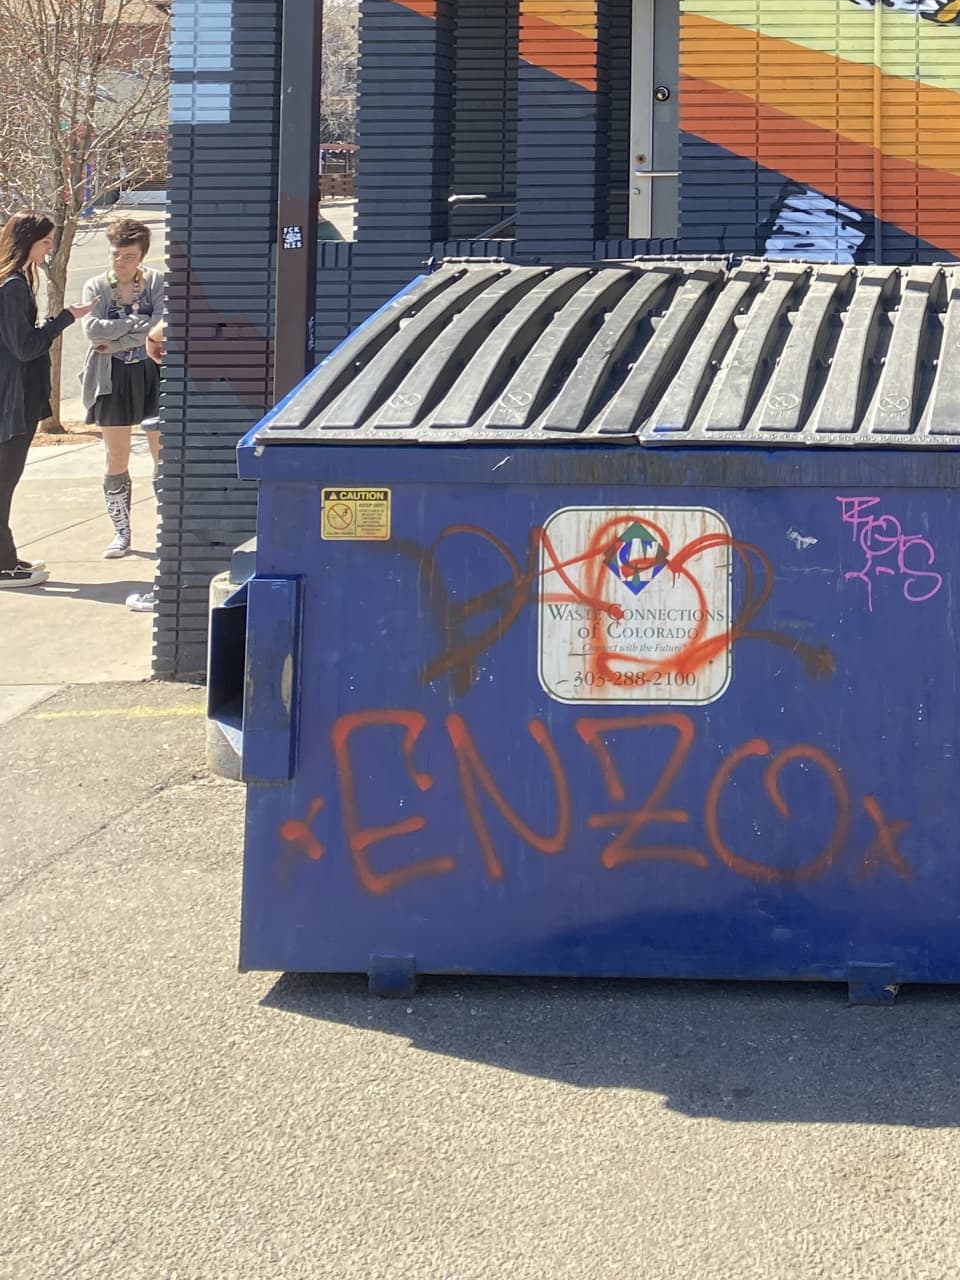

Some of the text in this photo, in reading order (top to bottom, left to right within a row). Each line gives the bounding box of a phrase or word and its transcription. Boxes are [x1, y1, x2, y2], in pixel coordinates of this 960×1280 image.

[339, 491, 384, 500] CAUTION
[606, 621, 699, 640] COLORADO
[639, 643, 653, 653] the
